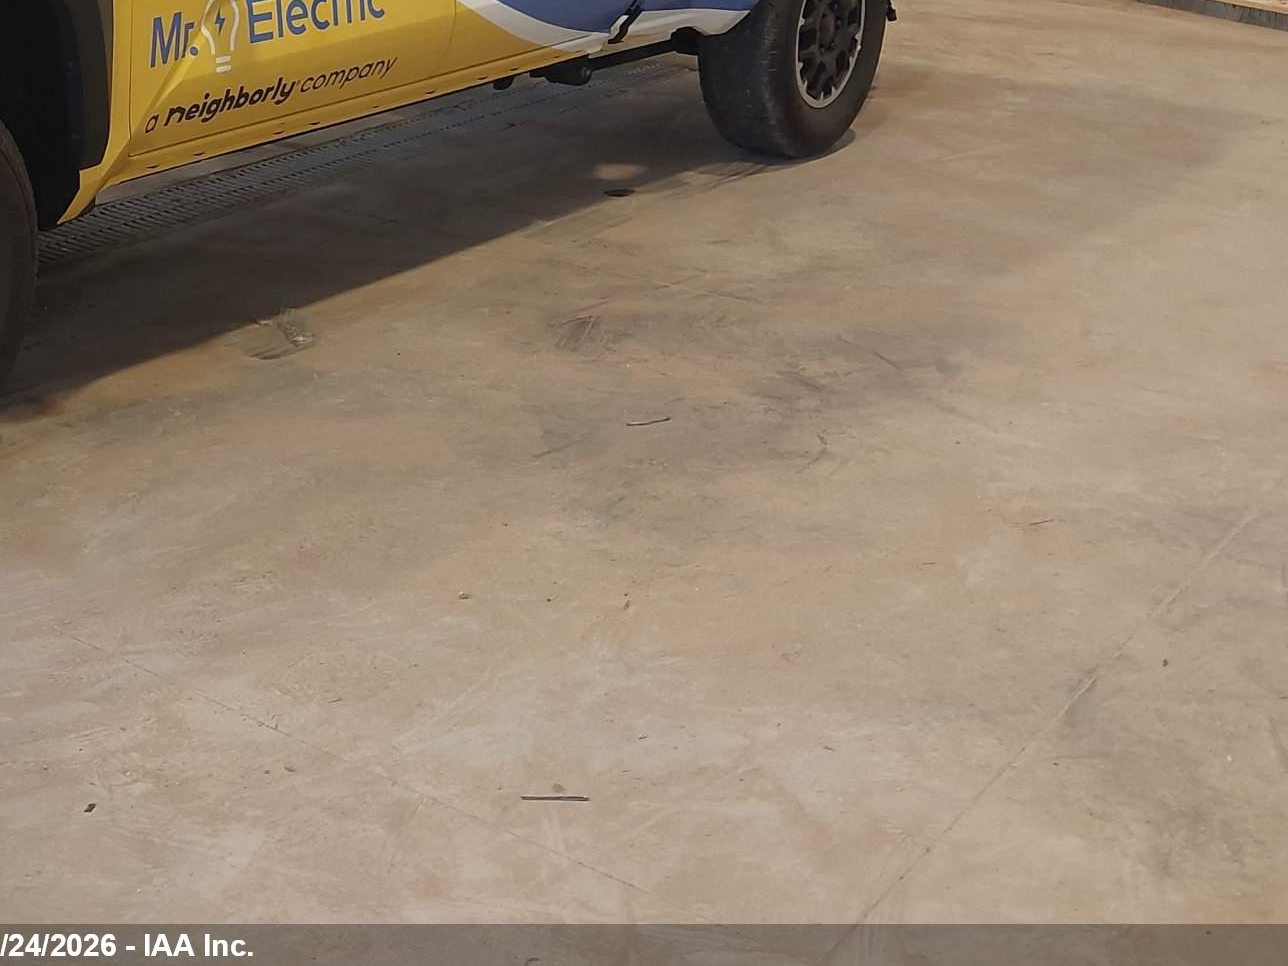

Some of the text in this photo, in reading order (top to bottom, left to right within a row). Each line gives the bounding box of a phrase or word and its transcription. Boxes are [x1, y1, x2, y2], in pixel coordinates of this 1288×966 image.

[150, 11, 199, 69] Mr.
[145, 57, 398, 134] a neighborly company
